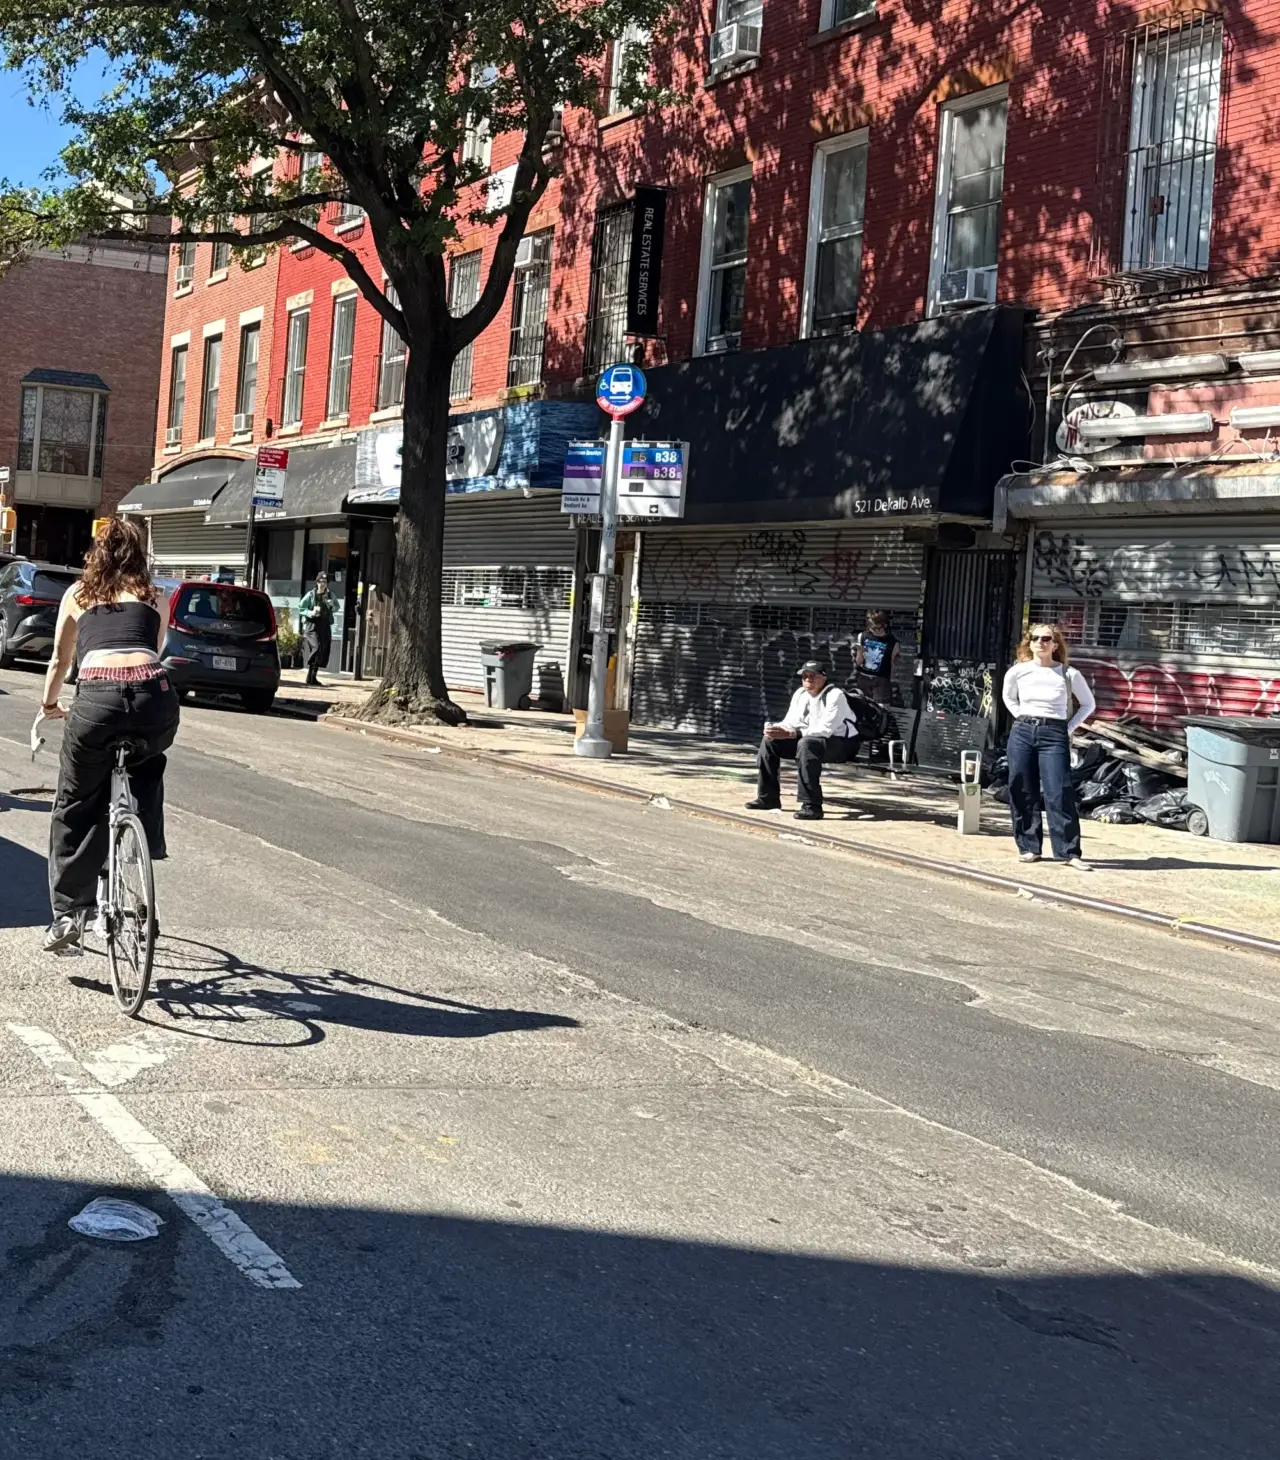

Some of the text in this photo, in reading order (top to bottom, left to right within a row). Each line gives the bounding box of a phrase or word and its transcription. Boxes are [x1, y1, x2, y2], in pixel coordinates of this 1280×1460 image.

[637, 207, 655, 316] REAL ESTATE SERVICES
[655, 451, 678, 463] B38
[653, 467, 676, 479] B38
[854, 495, 933, 513] 521 Dekalb Ave.
